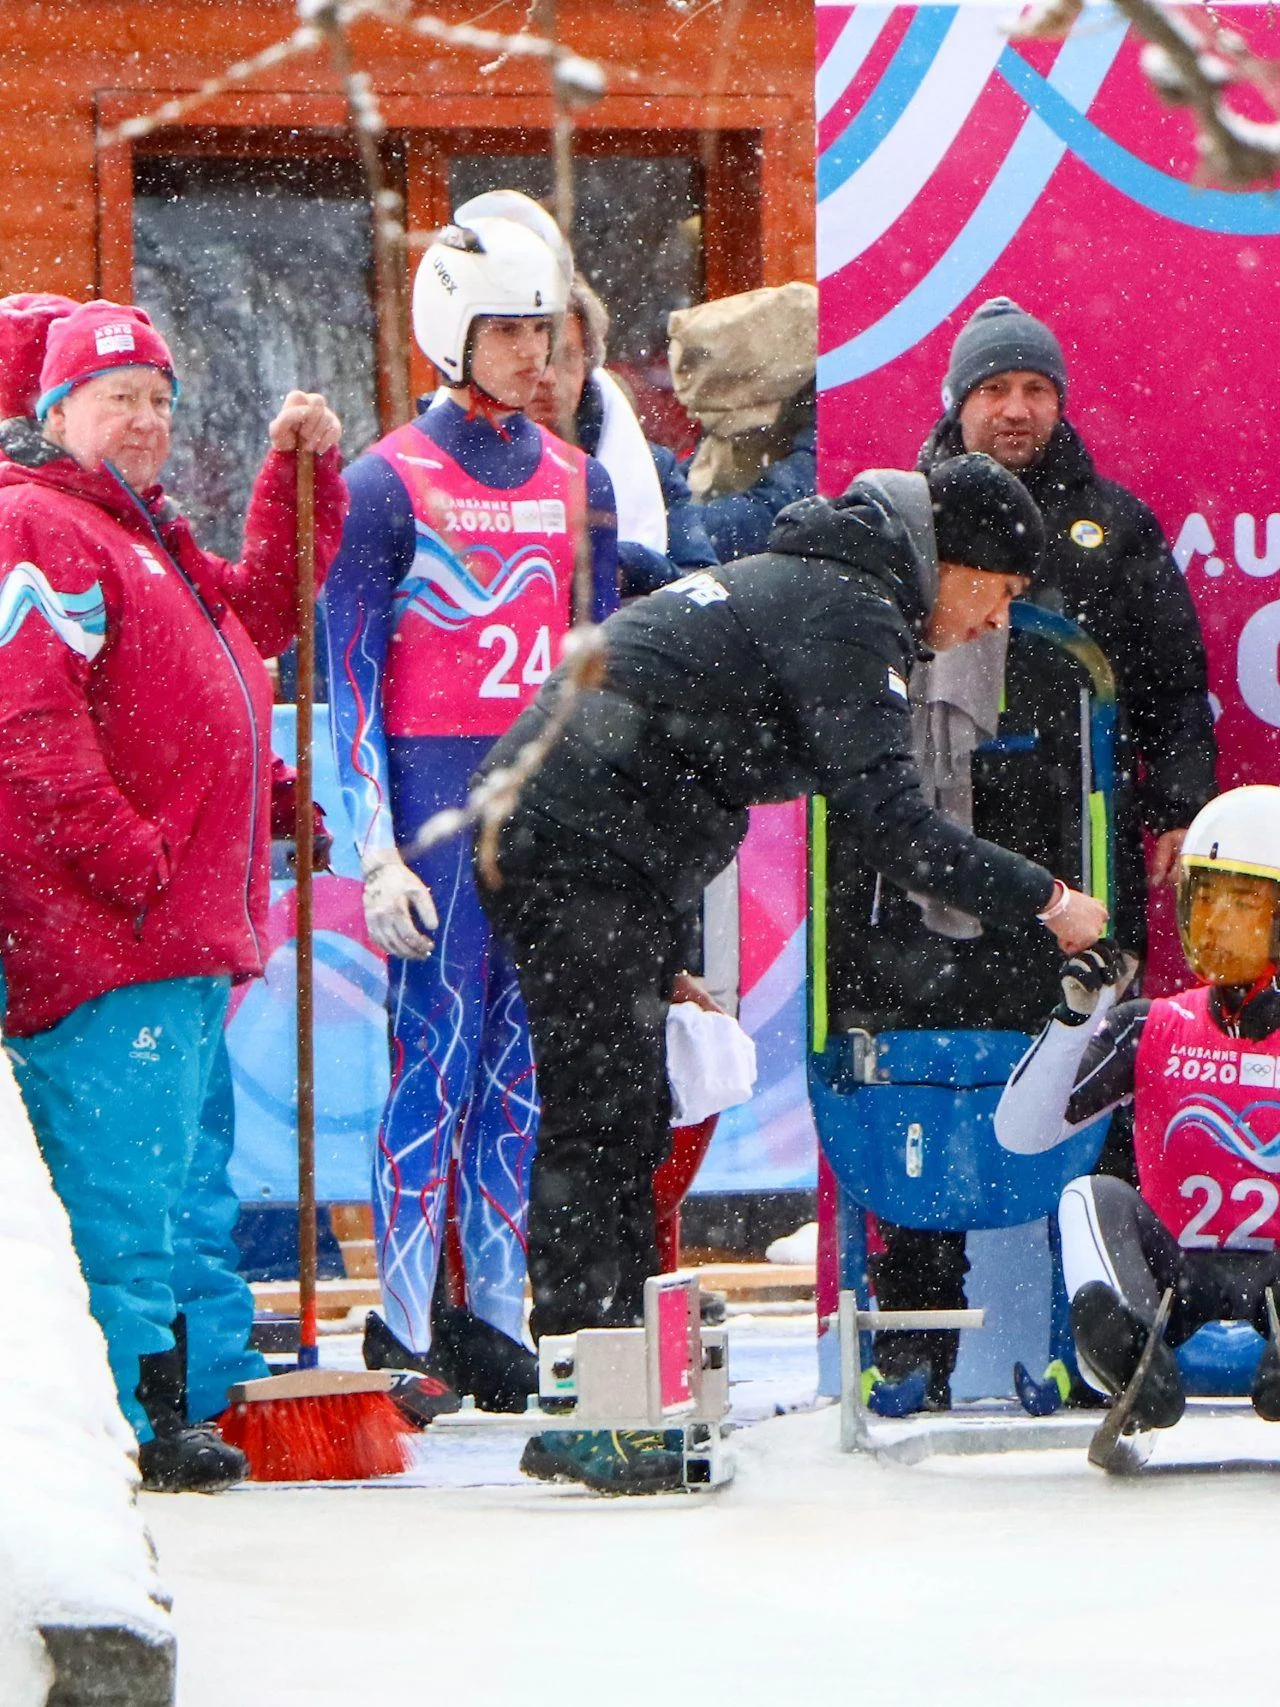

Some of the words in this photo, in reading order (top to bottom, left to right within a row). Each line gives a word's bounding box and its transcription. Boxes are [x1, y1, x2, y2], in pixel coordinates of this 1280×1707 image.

[433, 257, 458, 296] uvex
[444, 498, 509, 512] AUSANNE
[478, 624, 551, 698] 24
[1170, 1043, 1238, 1062] LAUSANNE
[1163, 1056, 1238, 1084] 2020
[1178, 1174, 1279, 1251] 22
